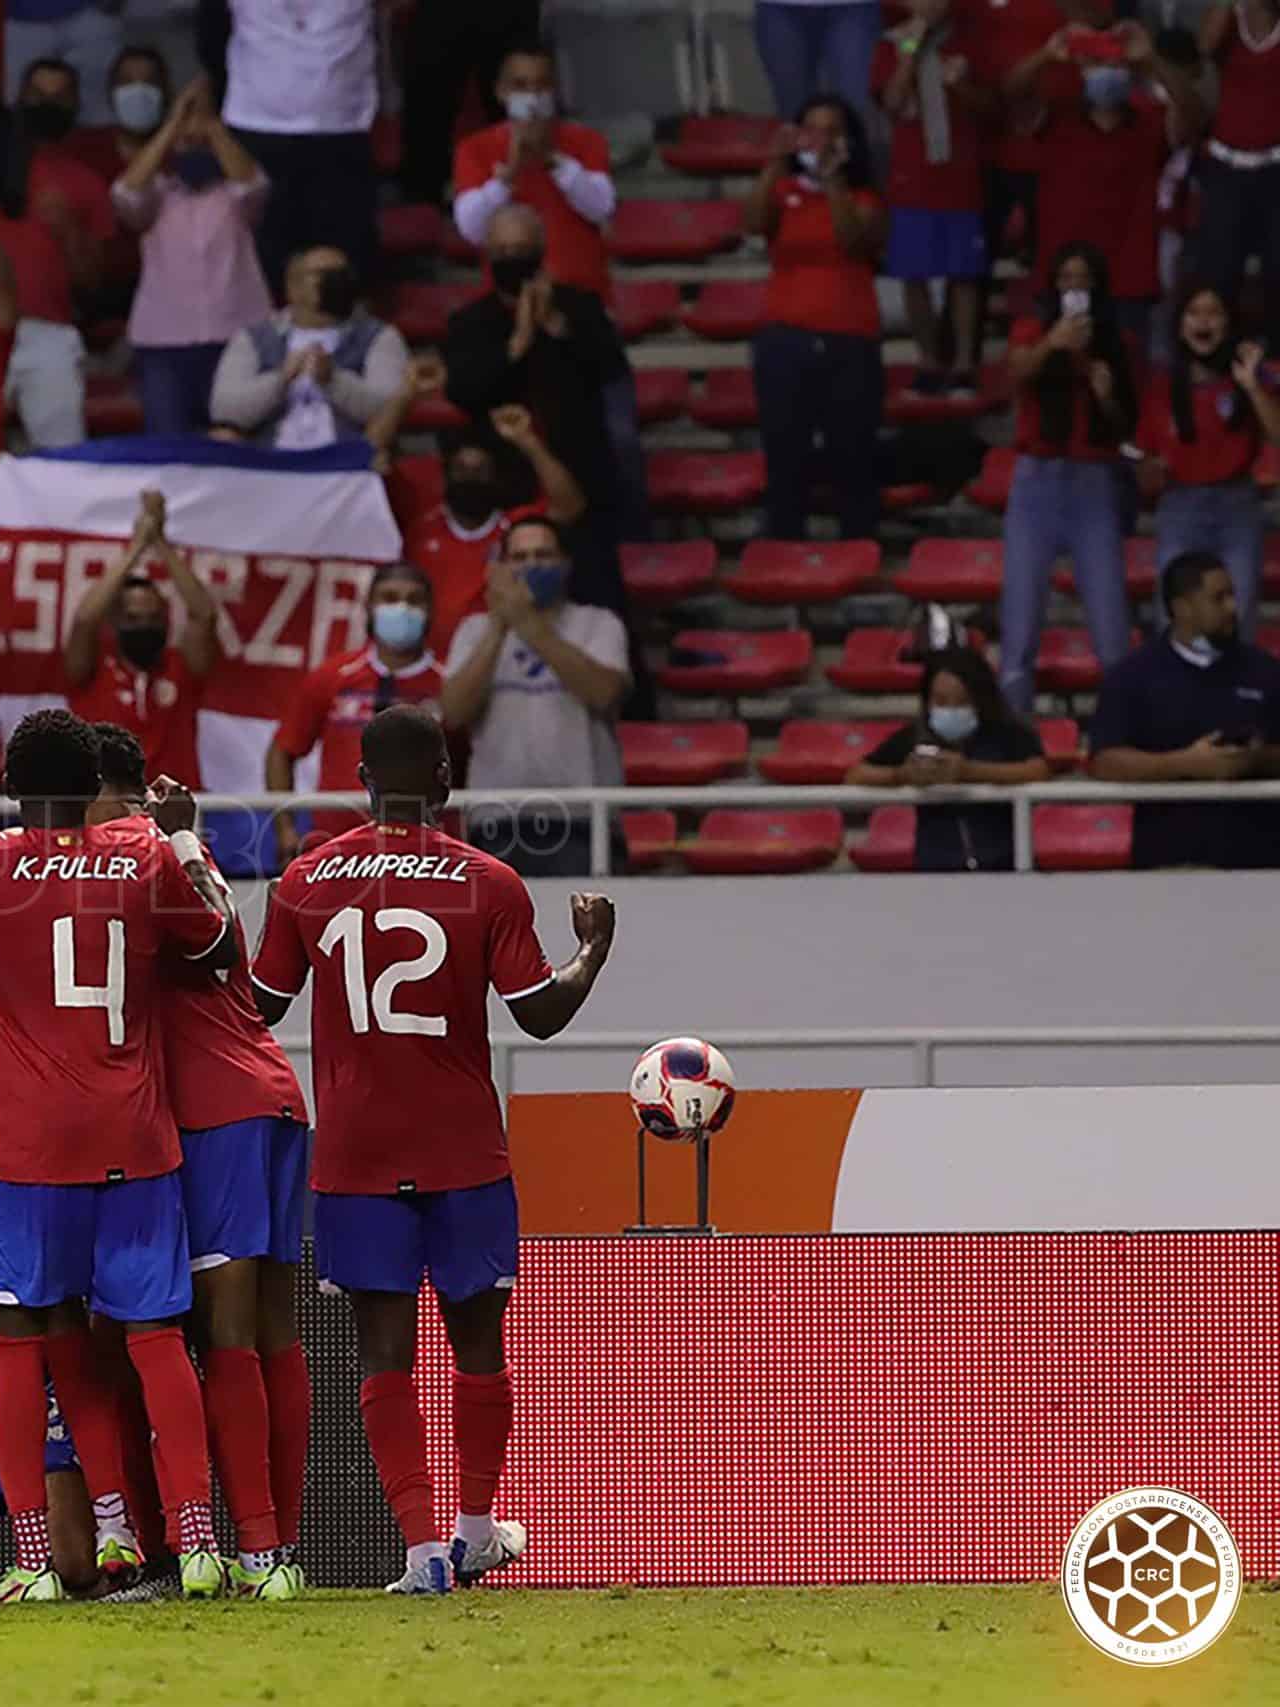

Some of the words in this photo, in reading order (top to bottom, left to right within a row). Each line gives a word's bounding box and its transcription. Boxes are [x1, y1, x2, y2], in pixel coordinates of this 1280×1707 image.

[12, 855, 139, 881] K.FULLER
[306, 853, 468, 884] J.CAMPBELL
[52, 916, 125, 1046] 4
[317, 906, 448, 1037] 12
